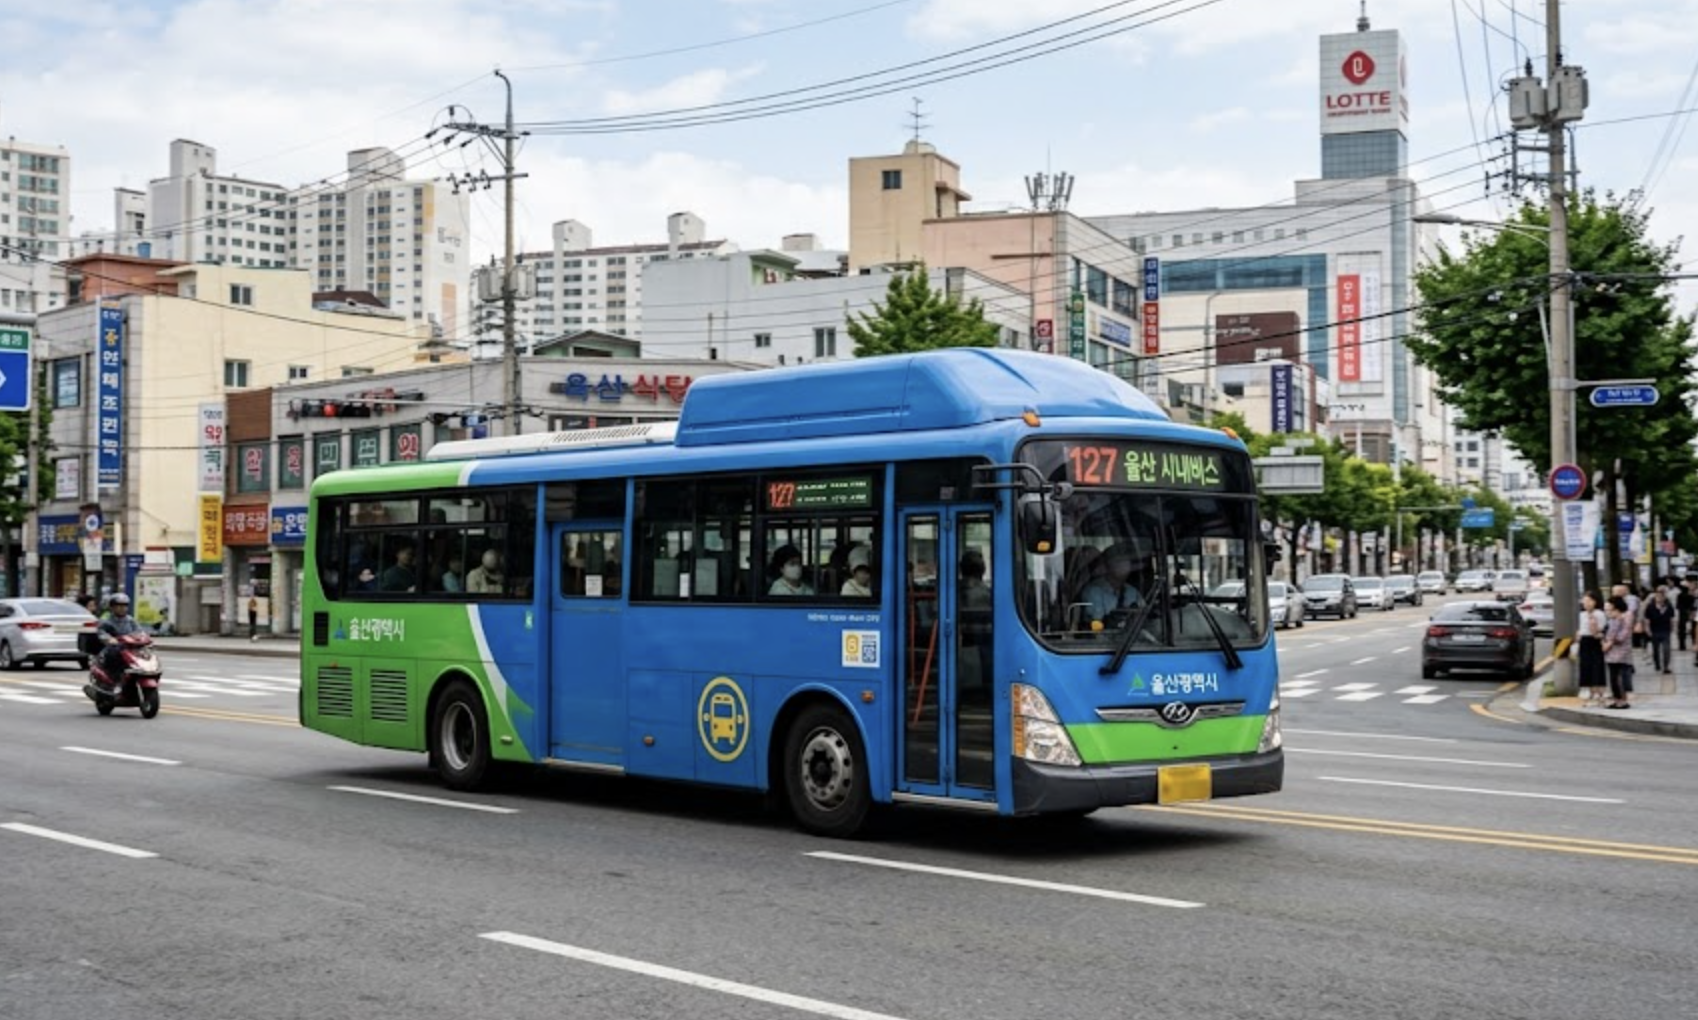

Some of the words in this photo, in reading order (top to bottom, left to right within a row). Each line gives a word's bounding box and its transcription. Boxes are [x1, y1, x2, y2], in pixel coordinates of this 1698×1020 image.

[1326, 90, 1391, 109] LOTTE
[1069, 446, 1119, 483] 127
[1123, 450, 1157, 482] 울산
[769, 483, 795, 508] 127
[1150, 672, 1219, 696] 울산광역시
